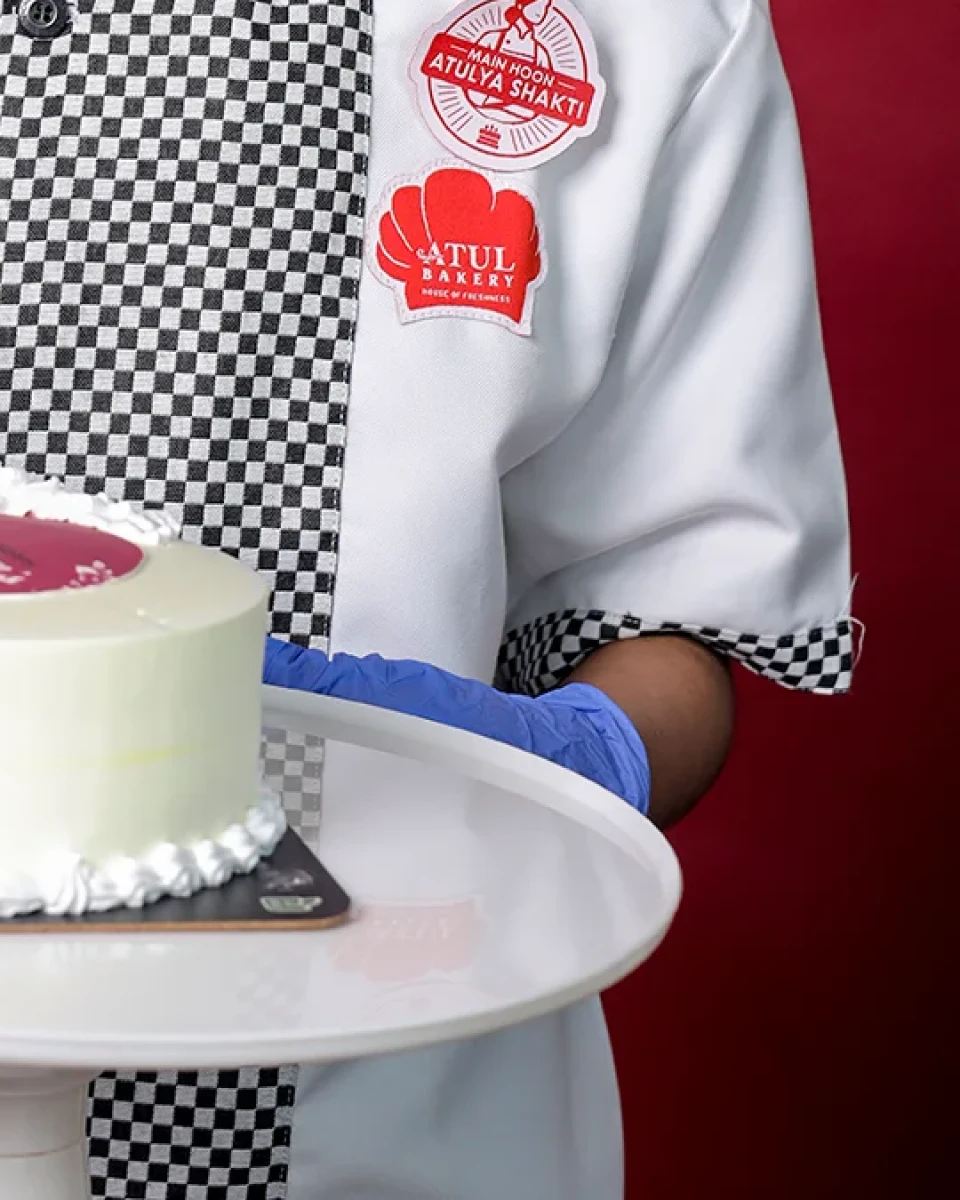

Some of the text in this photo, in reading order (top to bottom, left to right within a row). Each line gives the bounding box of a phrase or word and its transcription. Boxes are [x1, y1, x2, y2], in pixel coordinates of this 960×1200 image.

[467, 48, 556, 88] MAIN HOON
[429, 52, 585, 120] ATULYA SHAKTI
[416, 241, 517, 272] ATUL
[422, 267, 515, 288] BAKERY
